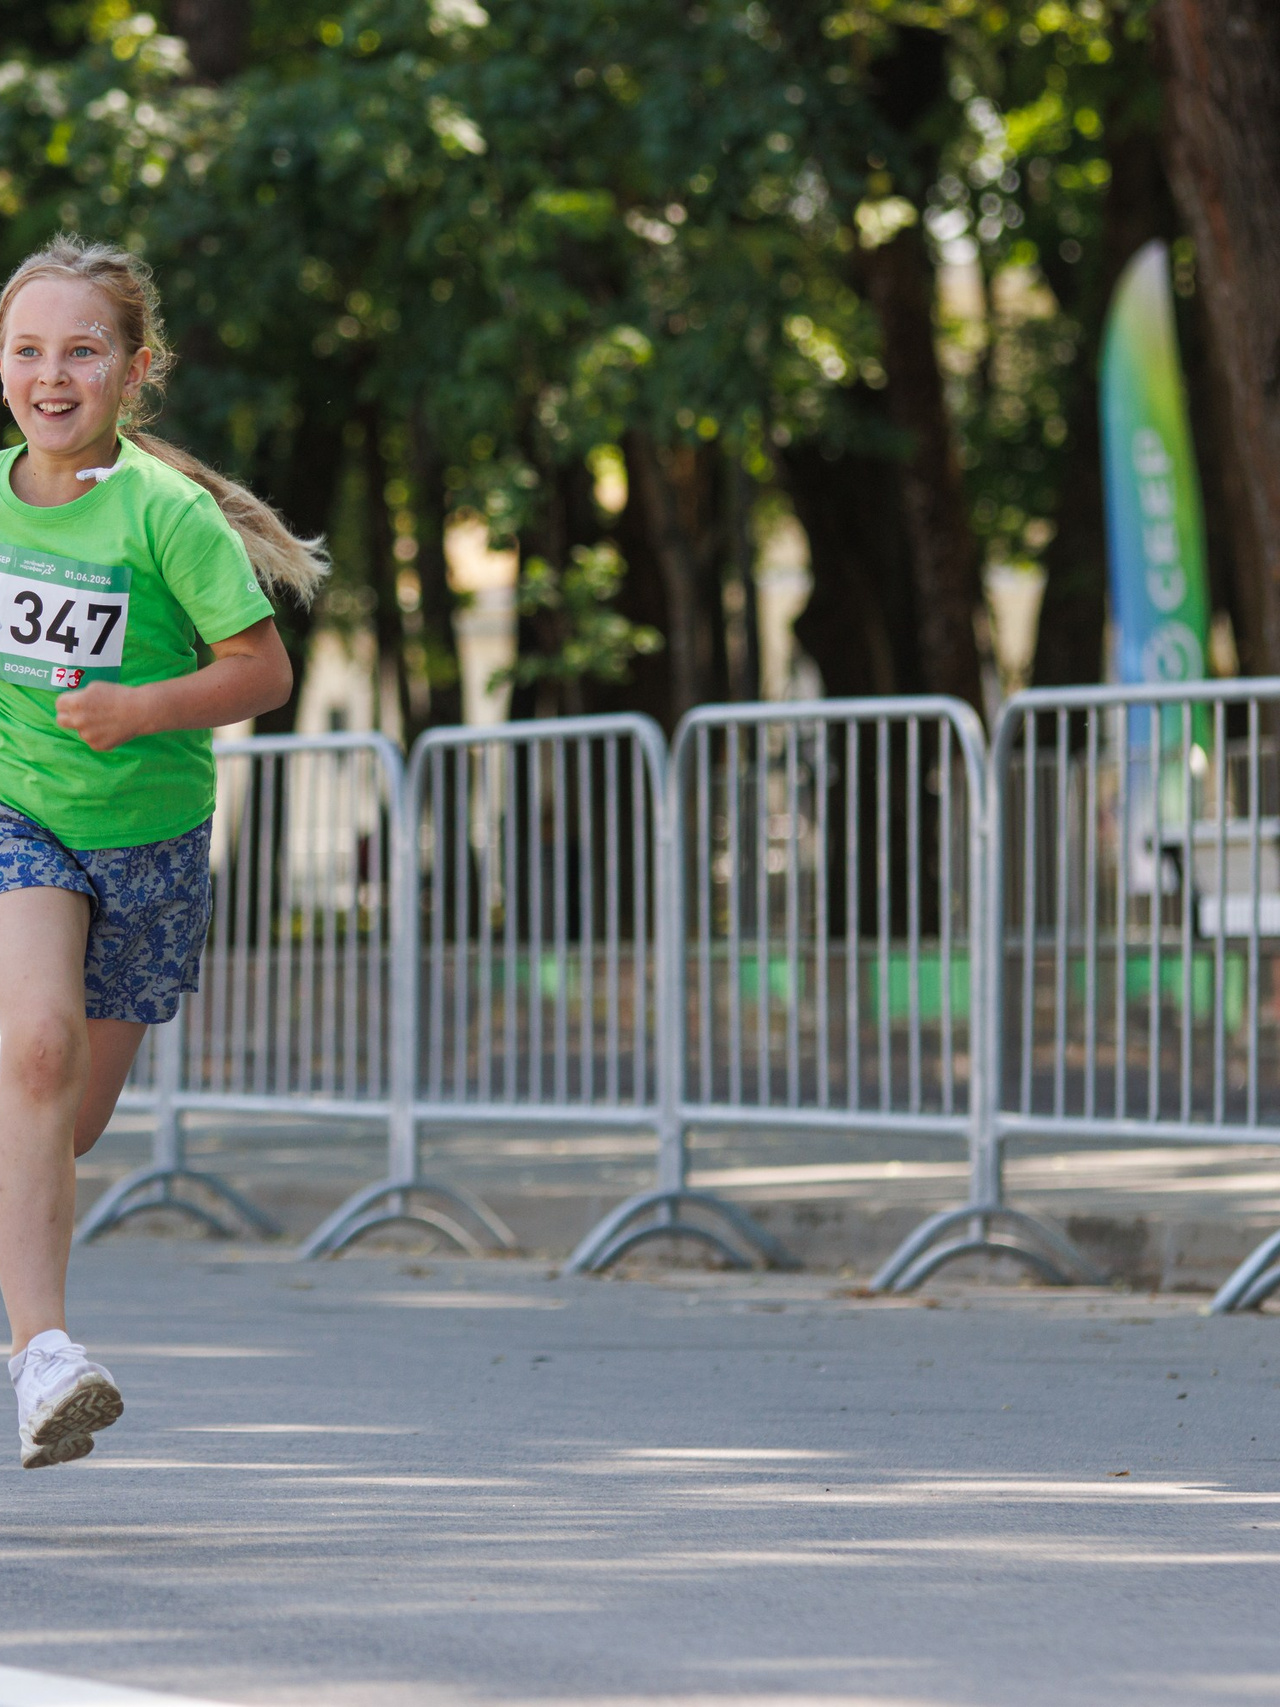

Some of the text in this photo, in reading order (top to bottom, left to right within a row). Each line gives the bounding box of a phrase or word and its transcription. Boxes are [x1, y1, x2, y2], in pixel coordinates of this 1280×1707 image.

[64, 570, 111, 586] 01.06.2024
[10, 590, 122, 656] 347
[4, 662, 49, 678] ВОЗРАСТ
